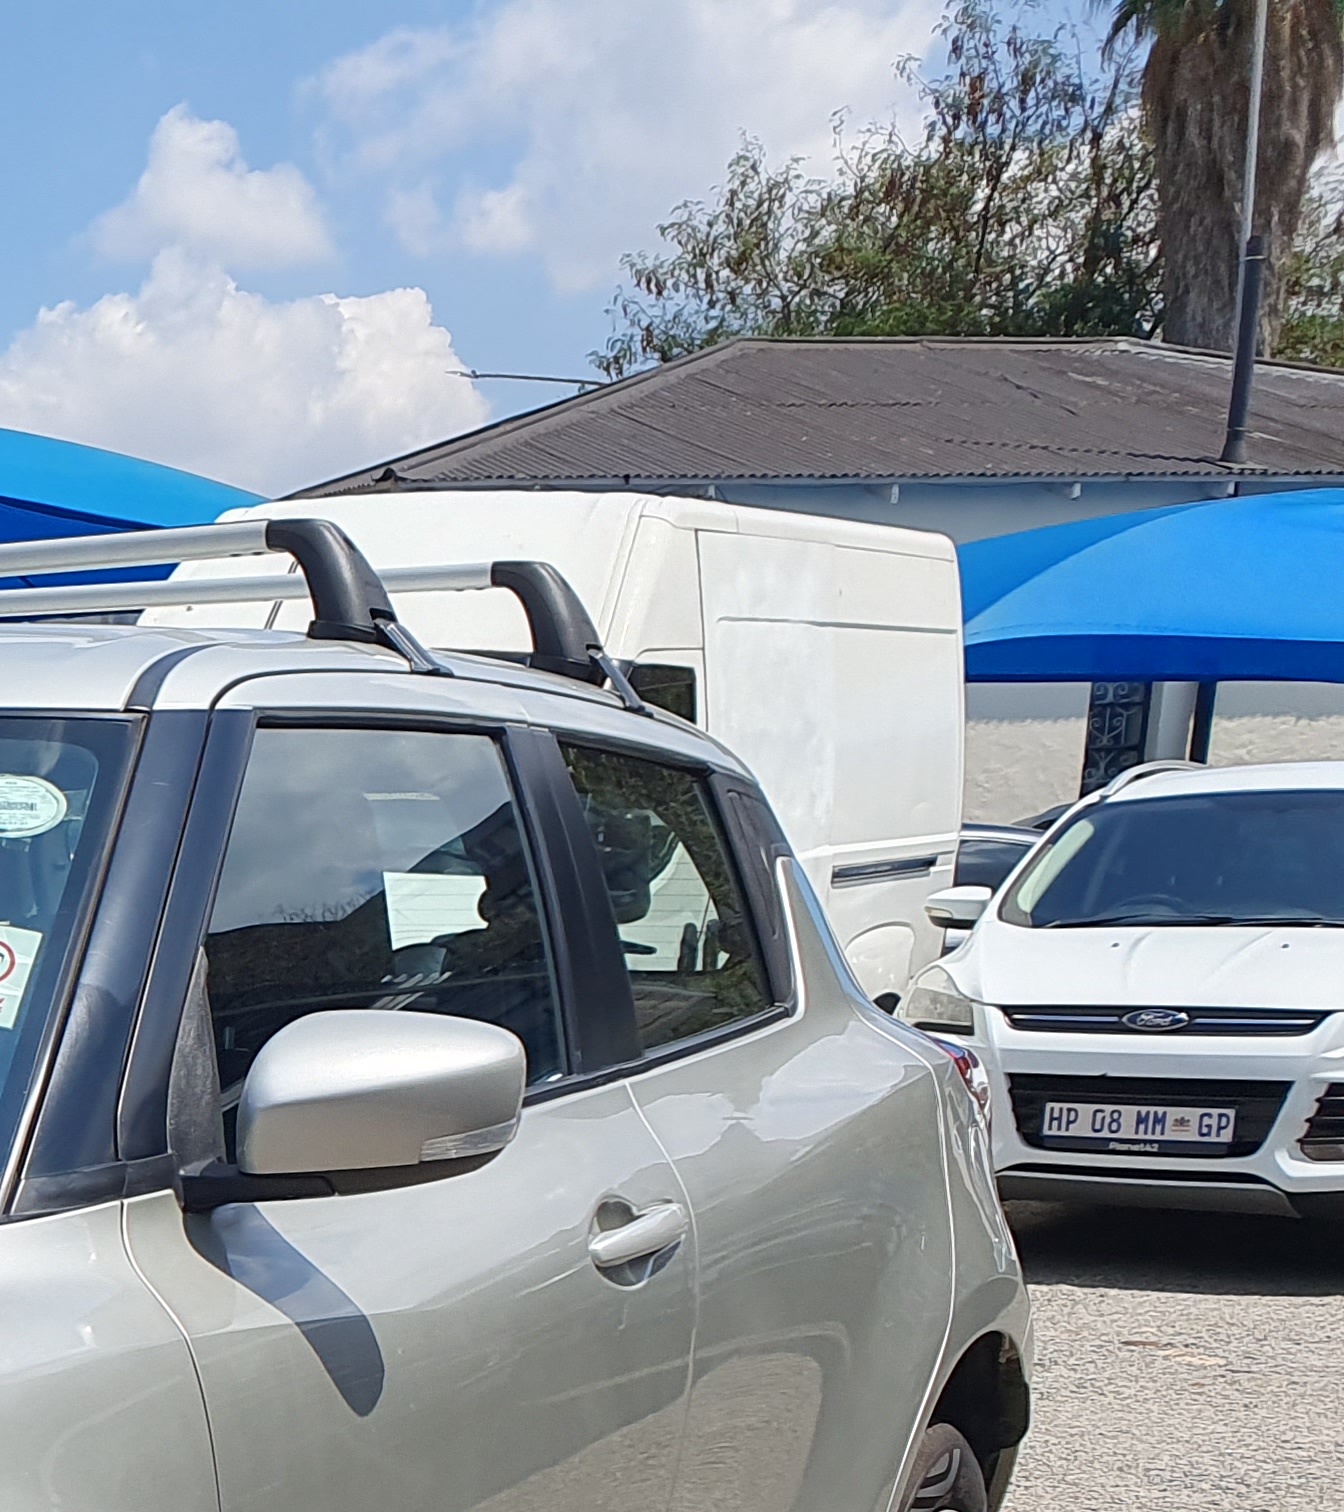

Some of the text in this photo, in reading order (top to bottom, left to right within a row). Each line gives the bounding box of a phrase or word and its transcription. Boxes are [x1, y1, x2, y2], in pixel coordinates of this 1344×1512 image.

[1048, 1106, 1231, 1138] HP 08 MM GP
